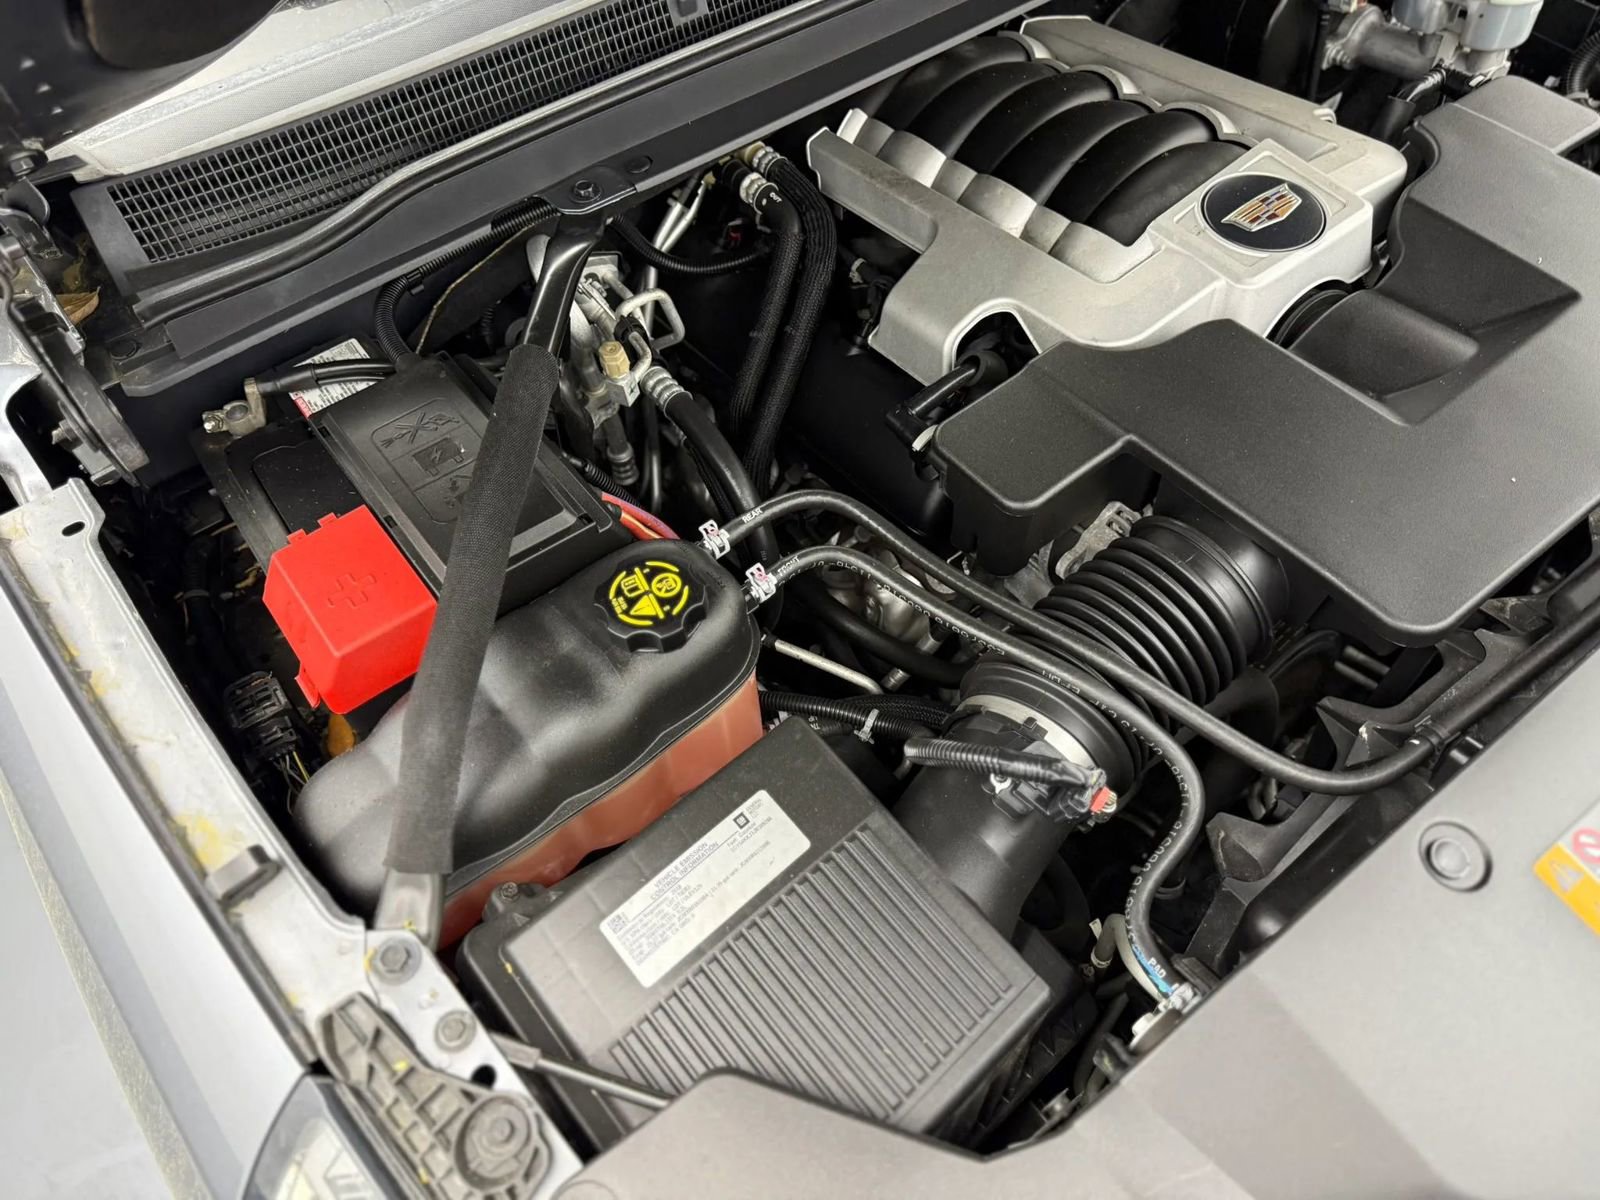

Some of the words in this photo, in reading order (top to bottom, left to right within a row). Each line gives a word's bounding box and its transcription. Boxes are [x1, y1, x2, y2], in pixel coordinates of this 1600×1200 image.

[742, 508, 763, 523] REAR
[778, 556, 799, 577] FRONT
[650, 876, 681, 900] CONTROL
[679, 842, 718, 876] INFORMATION
[654, 865, 680, 888] VEHICLE
[680, 842, 707, 867] EMISSION
